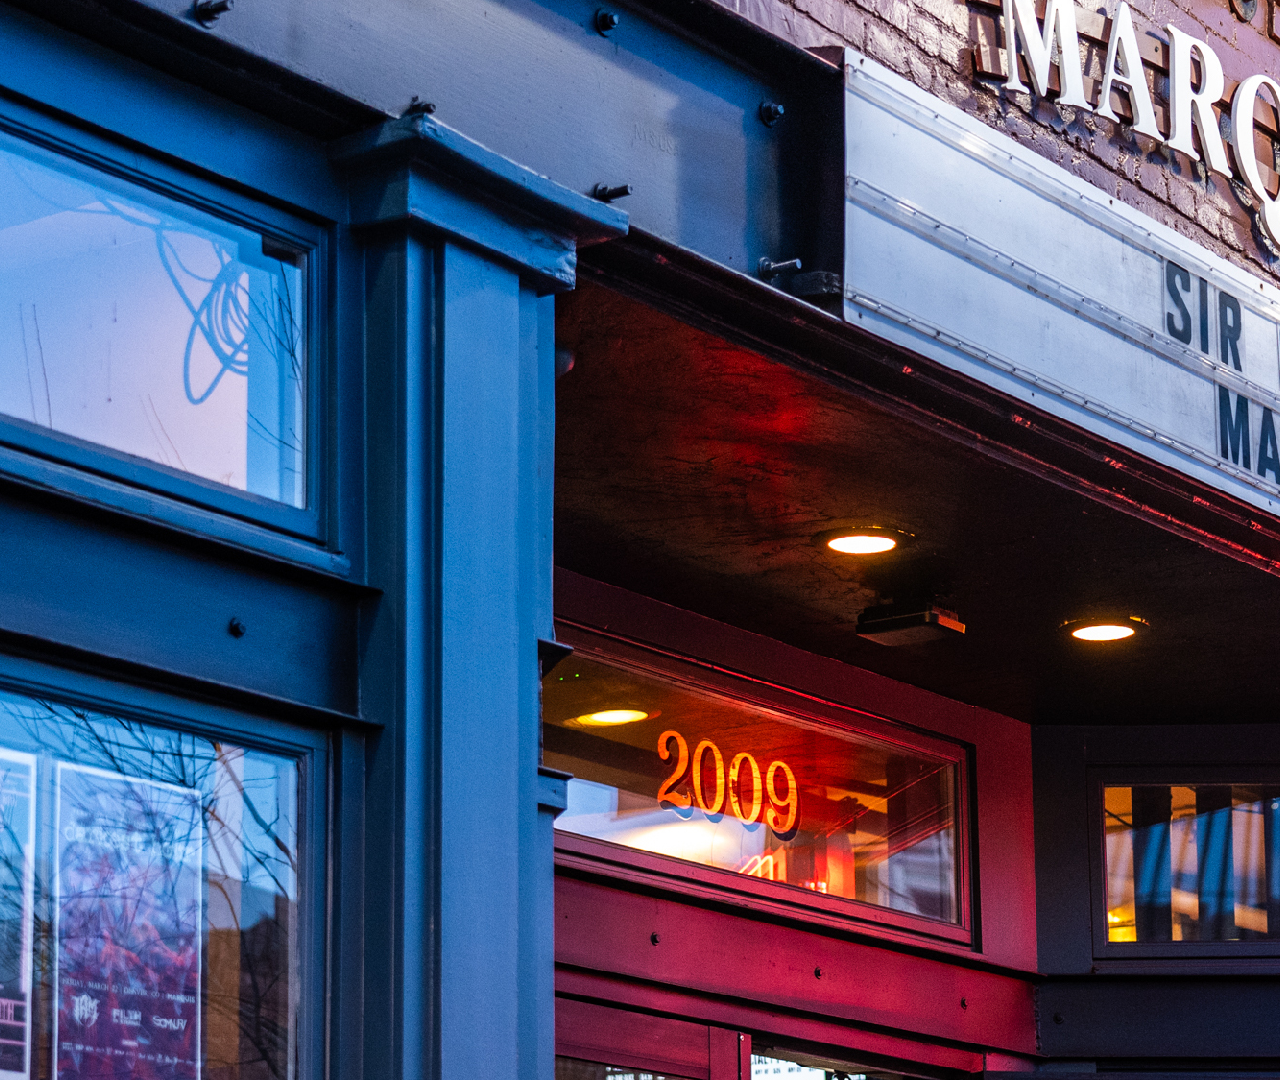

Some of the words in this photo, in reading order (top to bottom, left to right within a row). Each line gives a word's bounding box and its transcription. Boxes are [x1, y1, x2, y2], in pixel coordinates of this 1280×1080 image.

[1164, 261, 1243, 372] SIR
[657, 730, 799, 838] 2009
[167, 993, 196, 1004] MARQUIS
